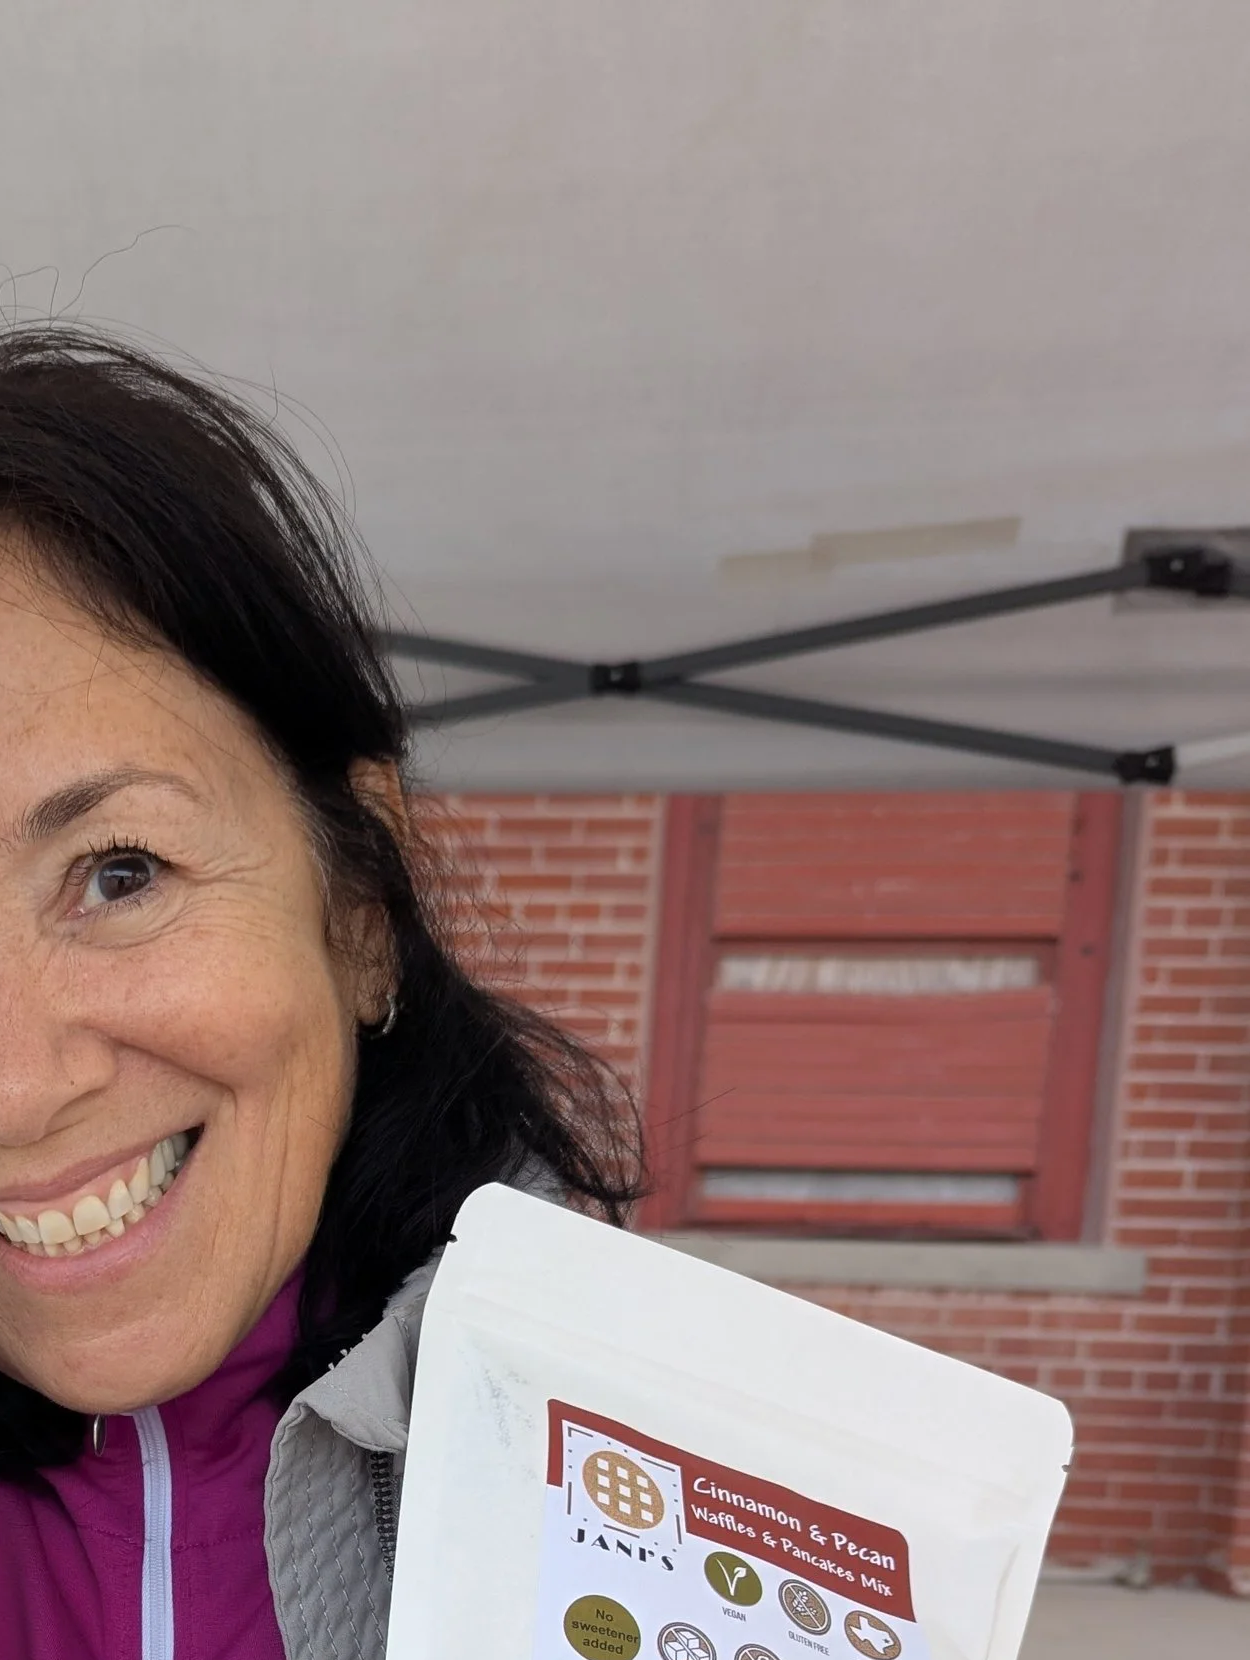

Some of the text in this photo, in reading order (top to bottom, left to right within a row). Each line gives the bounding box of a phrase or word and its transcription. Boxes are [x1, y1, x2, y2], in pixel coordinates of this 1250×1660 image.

[693, 1477, 896, 1571] Cinnamon & Pecan
[691, 1503, 893, 1597] Waffles & Pancakes Mix
[595, 1608, 614, 1622] No
[722, 1606, 746, 1622] VEGAN
[571, 1620, 639, 1644] sweetener
[788, 1630, 830, 1656] GLUTEN FREE
[582, 1637, 623, 1655] added
